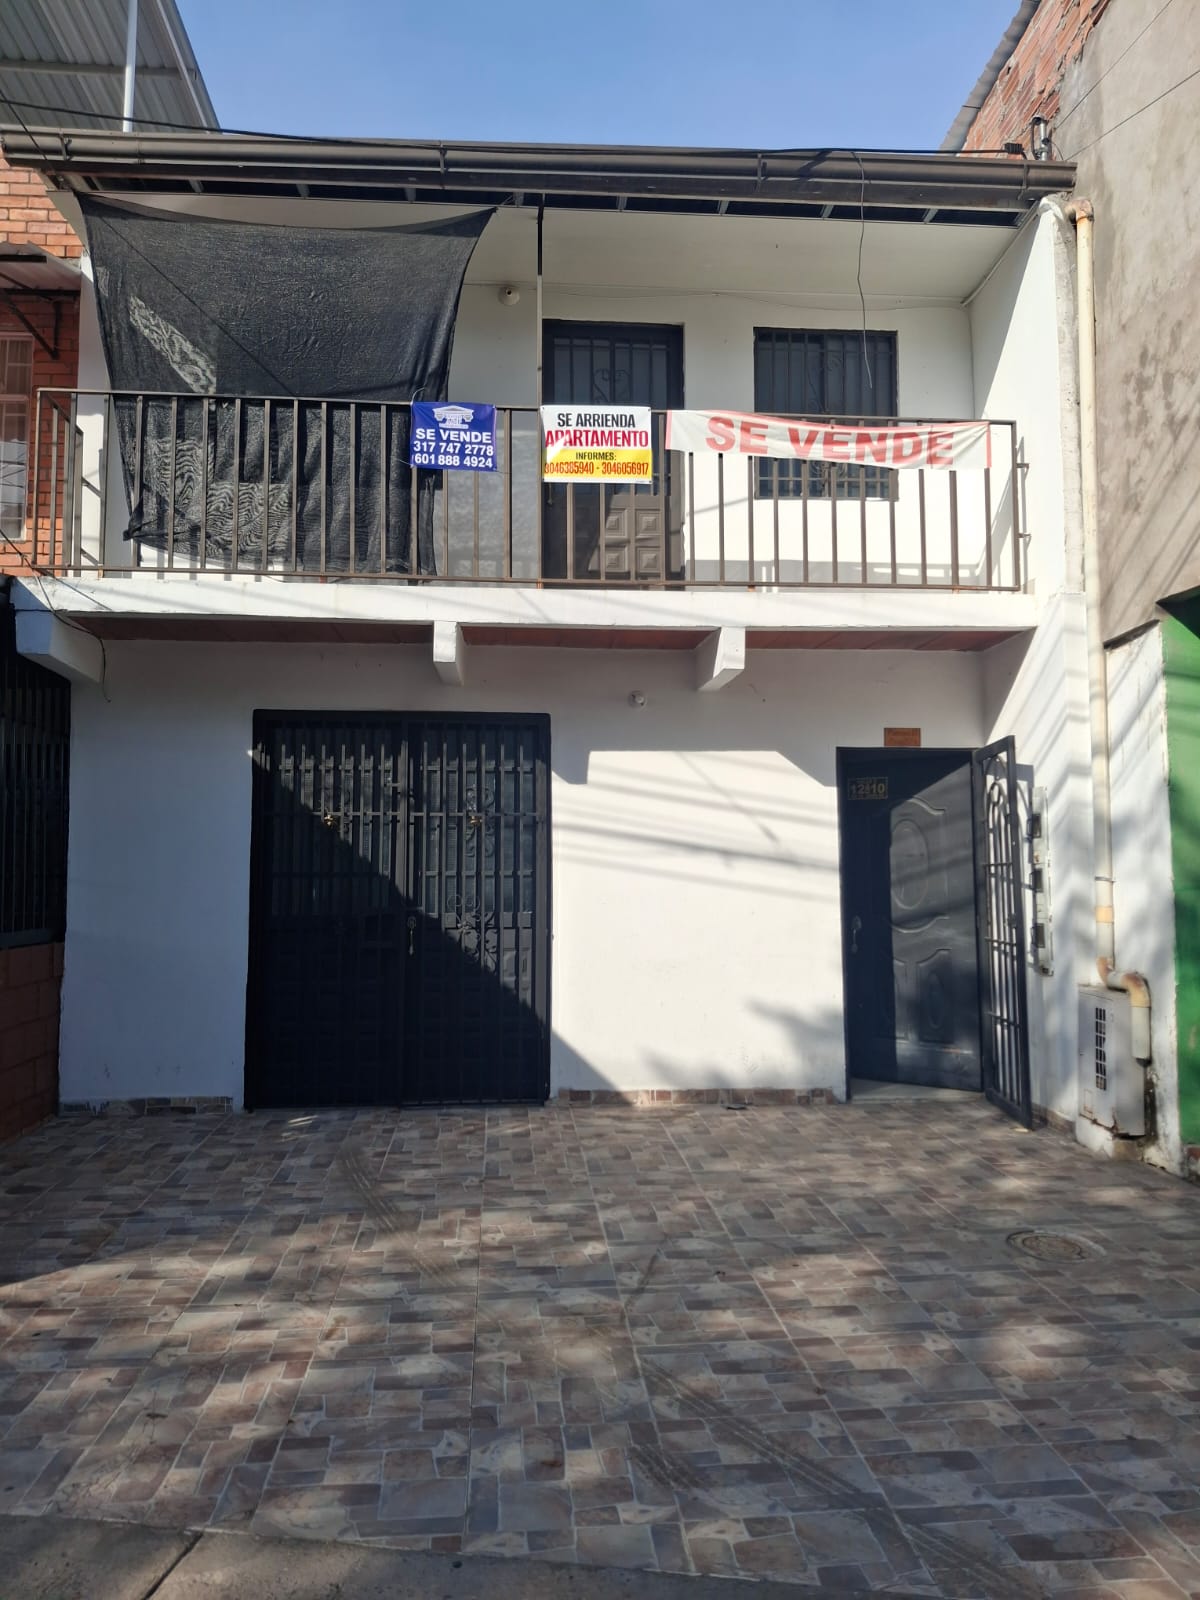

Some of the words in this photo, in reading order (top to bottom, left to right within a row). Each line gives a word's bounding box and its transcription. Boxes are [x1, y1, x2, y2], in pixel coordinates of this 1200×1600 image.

[557, 413, 573, 427] SE
[576, 413, 636, 428] ARRIENDA
[415, 428, 436, 440] SE
[439, 429, 492, 443] VENDE
[545, 429, 649, 447] APARTAMENTO
[705, 416, 769, 454] SE
[787, 427, 955, 466] VENDE
[413, 441, 436, 453] 317
[439, 442, 461, 454] 747
[464, 445, 494, 456] 2778
[575, 452, 617, 460] INFORMES:
[414, 453, 435, 464] 601
[438, 454, 460, 466] 888
[463, 456, 493, 468] 4924
[601, 462, 649, 475] 3046056917
